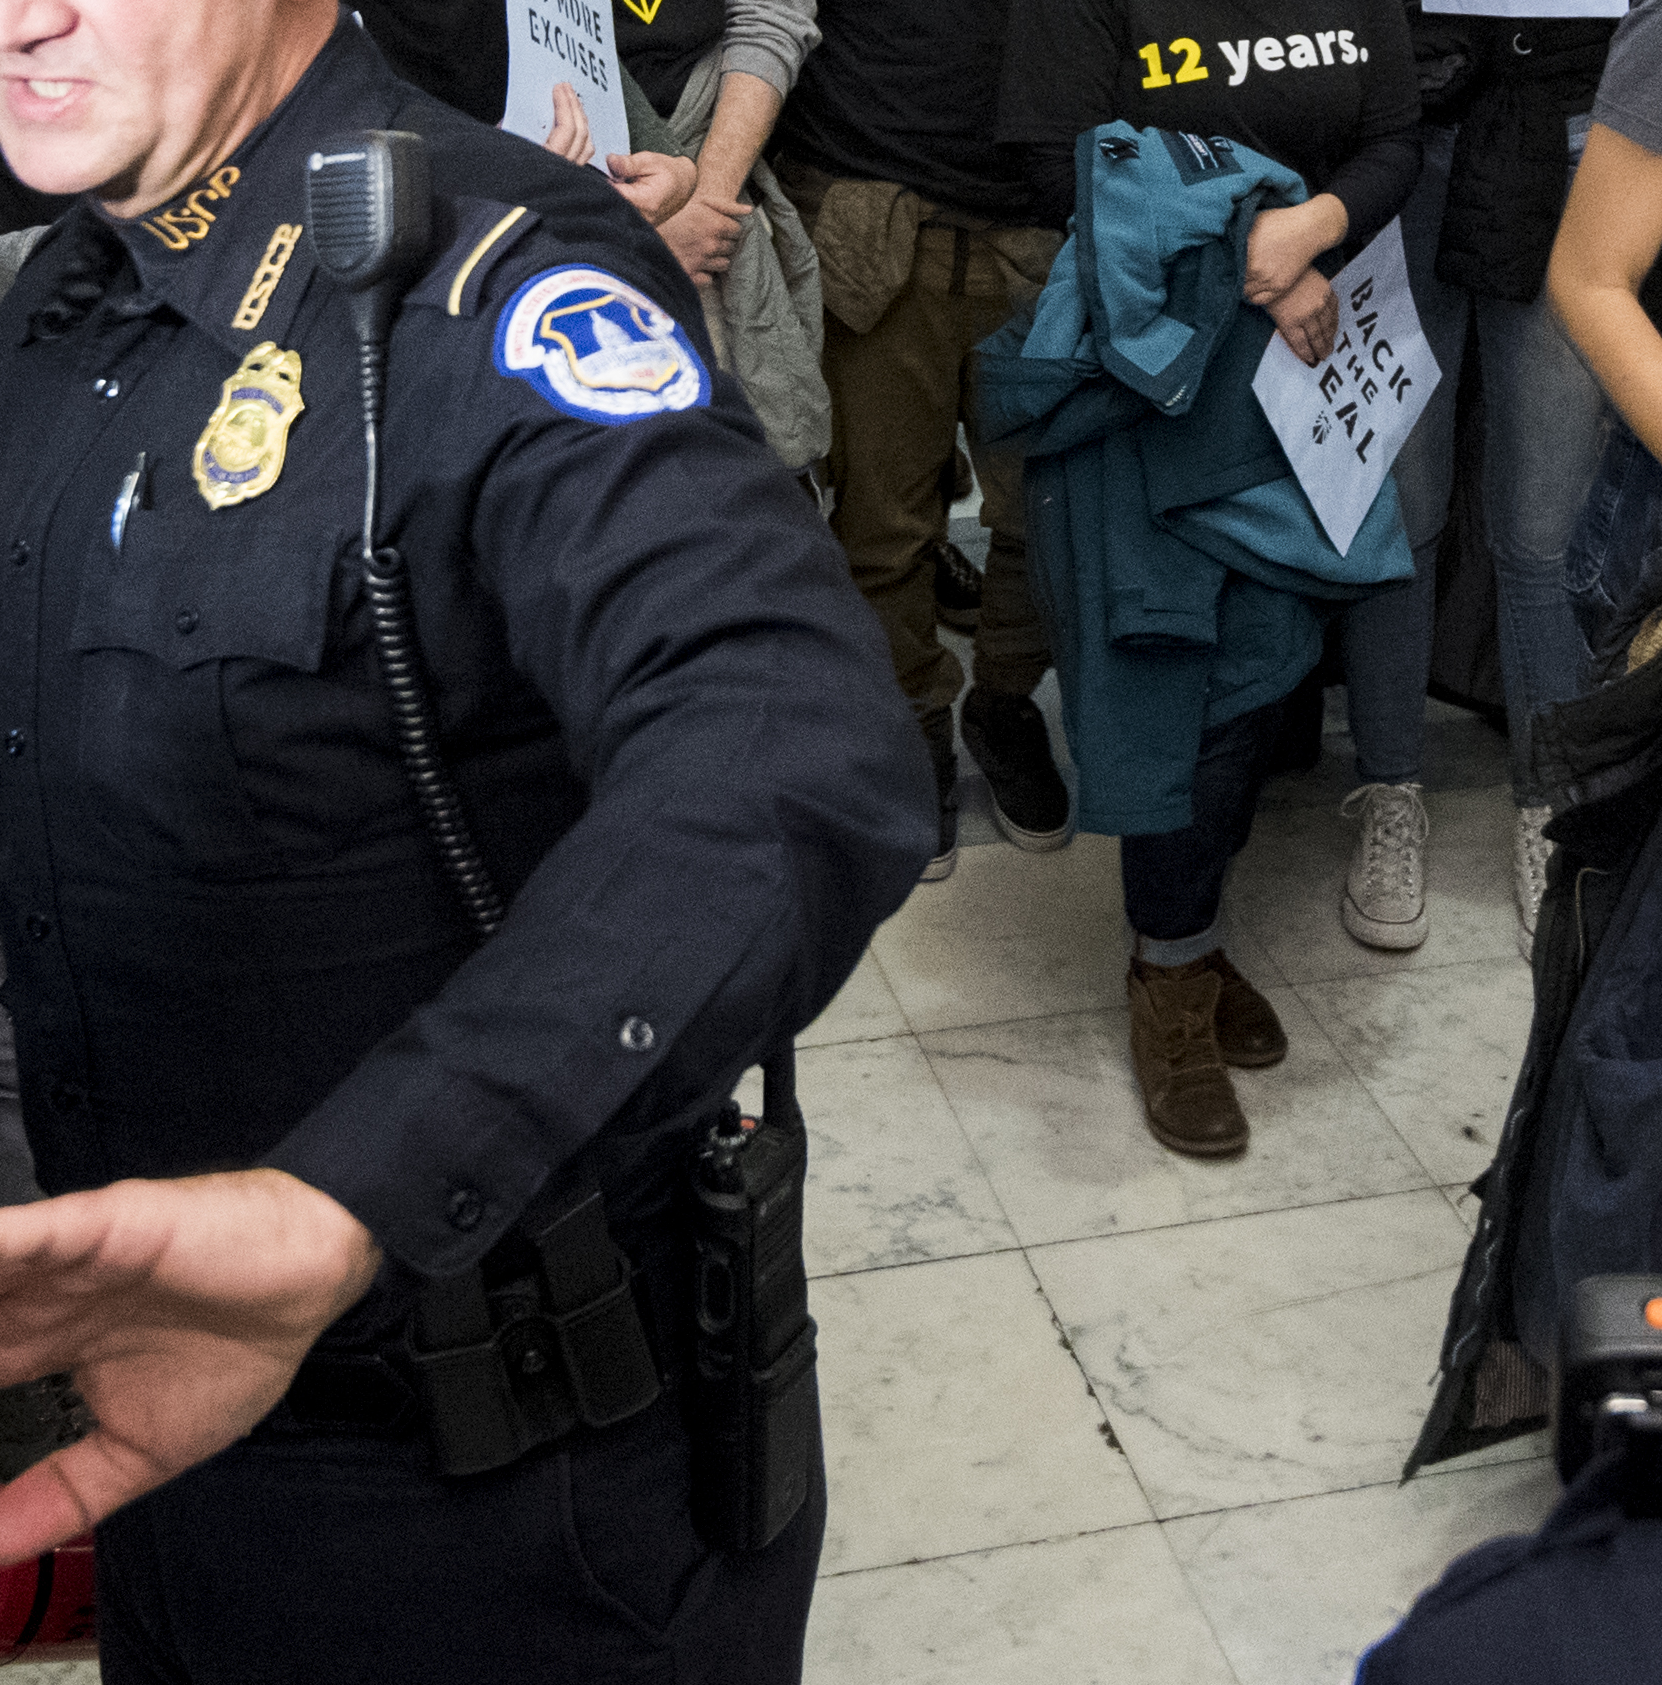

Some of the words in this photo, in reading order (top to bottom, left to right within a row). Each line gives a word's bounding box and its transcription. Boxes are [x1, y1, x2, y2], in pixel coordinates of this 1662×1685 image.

[527, 7, 608, 93] EXCUSES
[1138, 36, 1210, 89] 12
[1216, 27, 1369, 88] years.
[1336, 330, 1379, 406] THE
[1350, 276, 1413, 404] BACK
[1318, 362, 1376, 465] EAL
